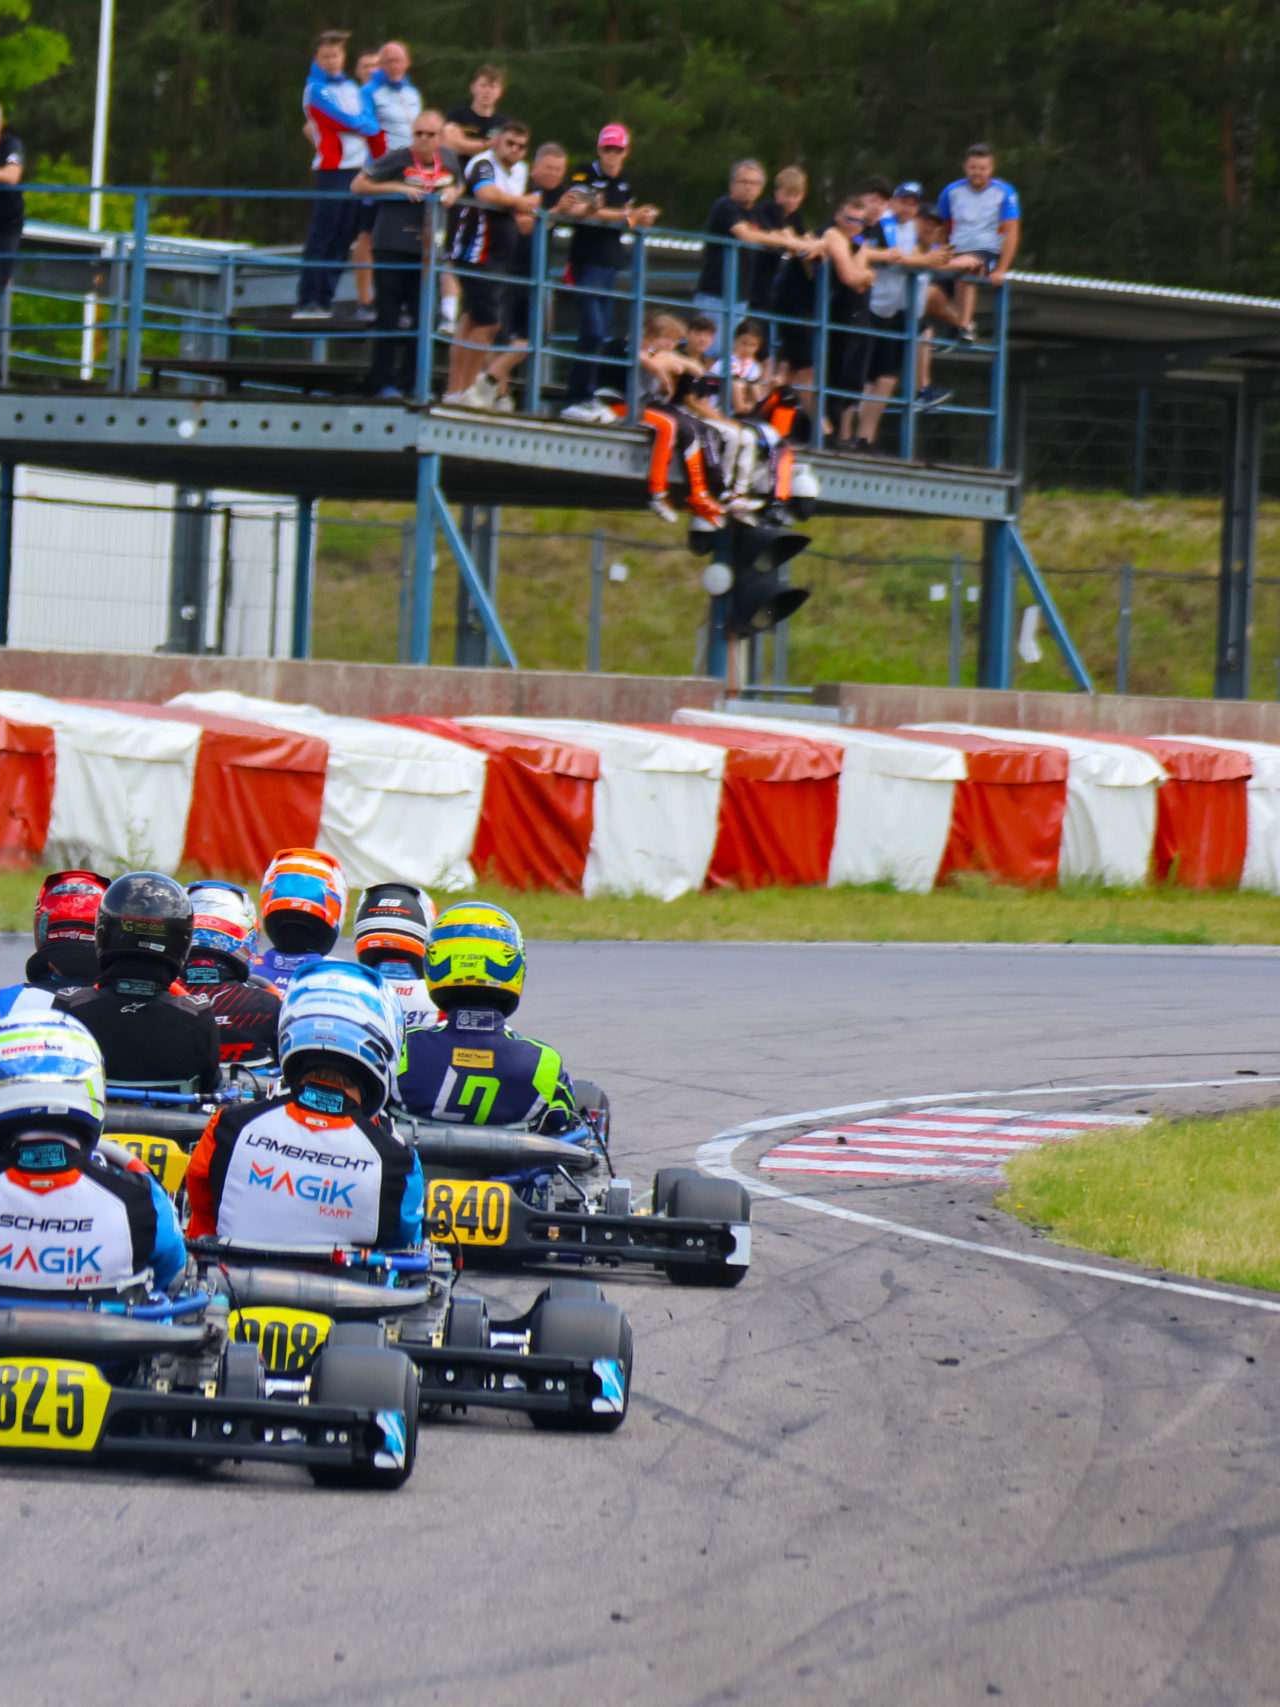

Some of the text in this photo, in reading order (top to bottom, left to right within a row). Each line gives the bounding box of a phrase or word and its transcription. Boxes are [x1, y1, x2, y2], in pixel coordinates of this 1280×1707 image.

[245, 1134, 374, 1173] LAMBRECHT
[319, 1205, 355, 1220] KART
[430, 1184, 505, 1241] 840
[66, 1274, 102, 1285] KART
